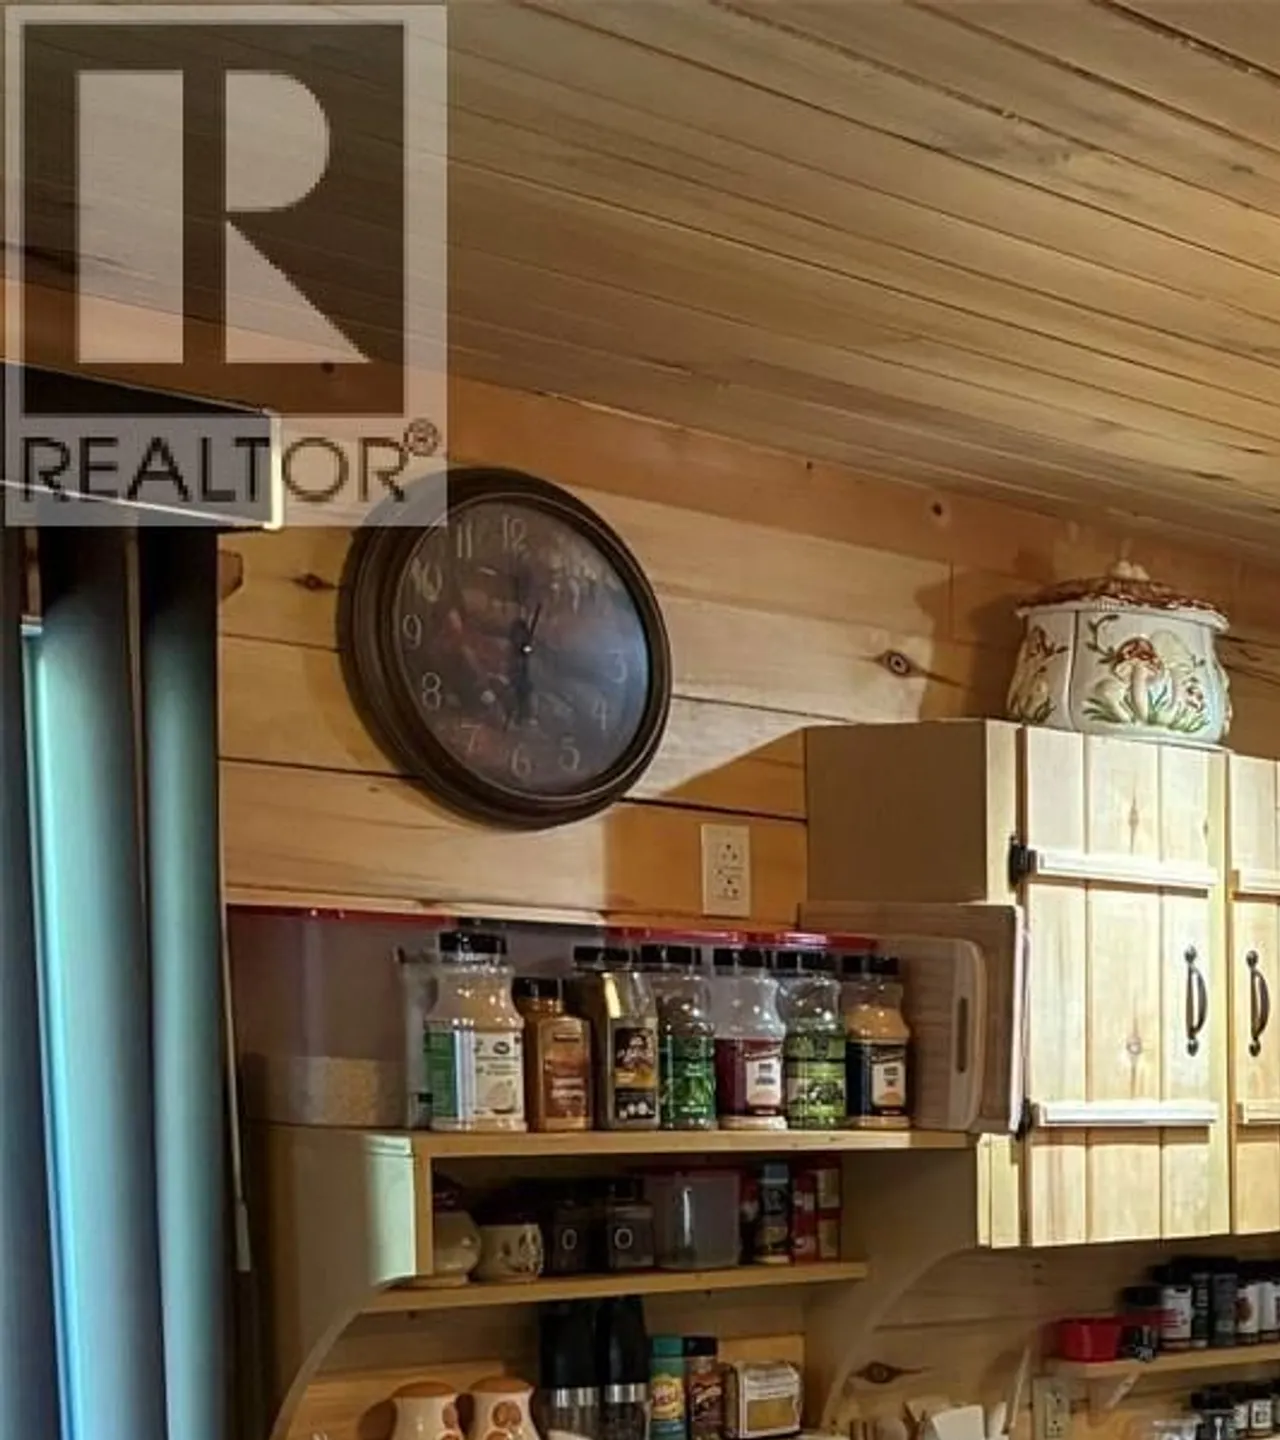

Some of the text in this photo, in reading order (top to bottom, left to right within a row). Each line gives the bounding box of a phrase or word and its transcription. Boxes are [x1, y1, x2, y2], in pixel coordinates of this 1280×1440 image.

[455, 521, 475, 559] 11
[501, 514, 529, 553] 12
[402, 613, 424, 650] 9
[611, 648, 631, 684] 3
[421, 671, 442, 711] 8
[591, 697, 608, 732] 4
[458, 722, 482, 755] 7
[557, 733, 581, 772] 5
[509, 744, 532, 779] 6
